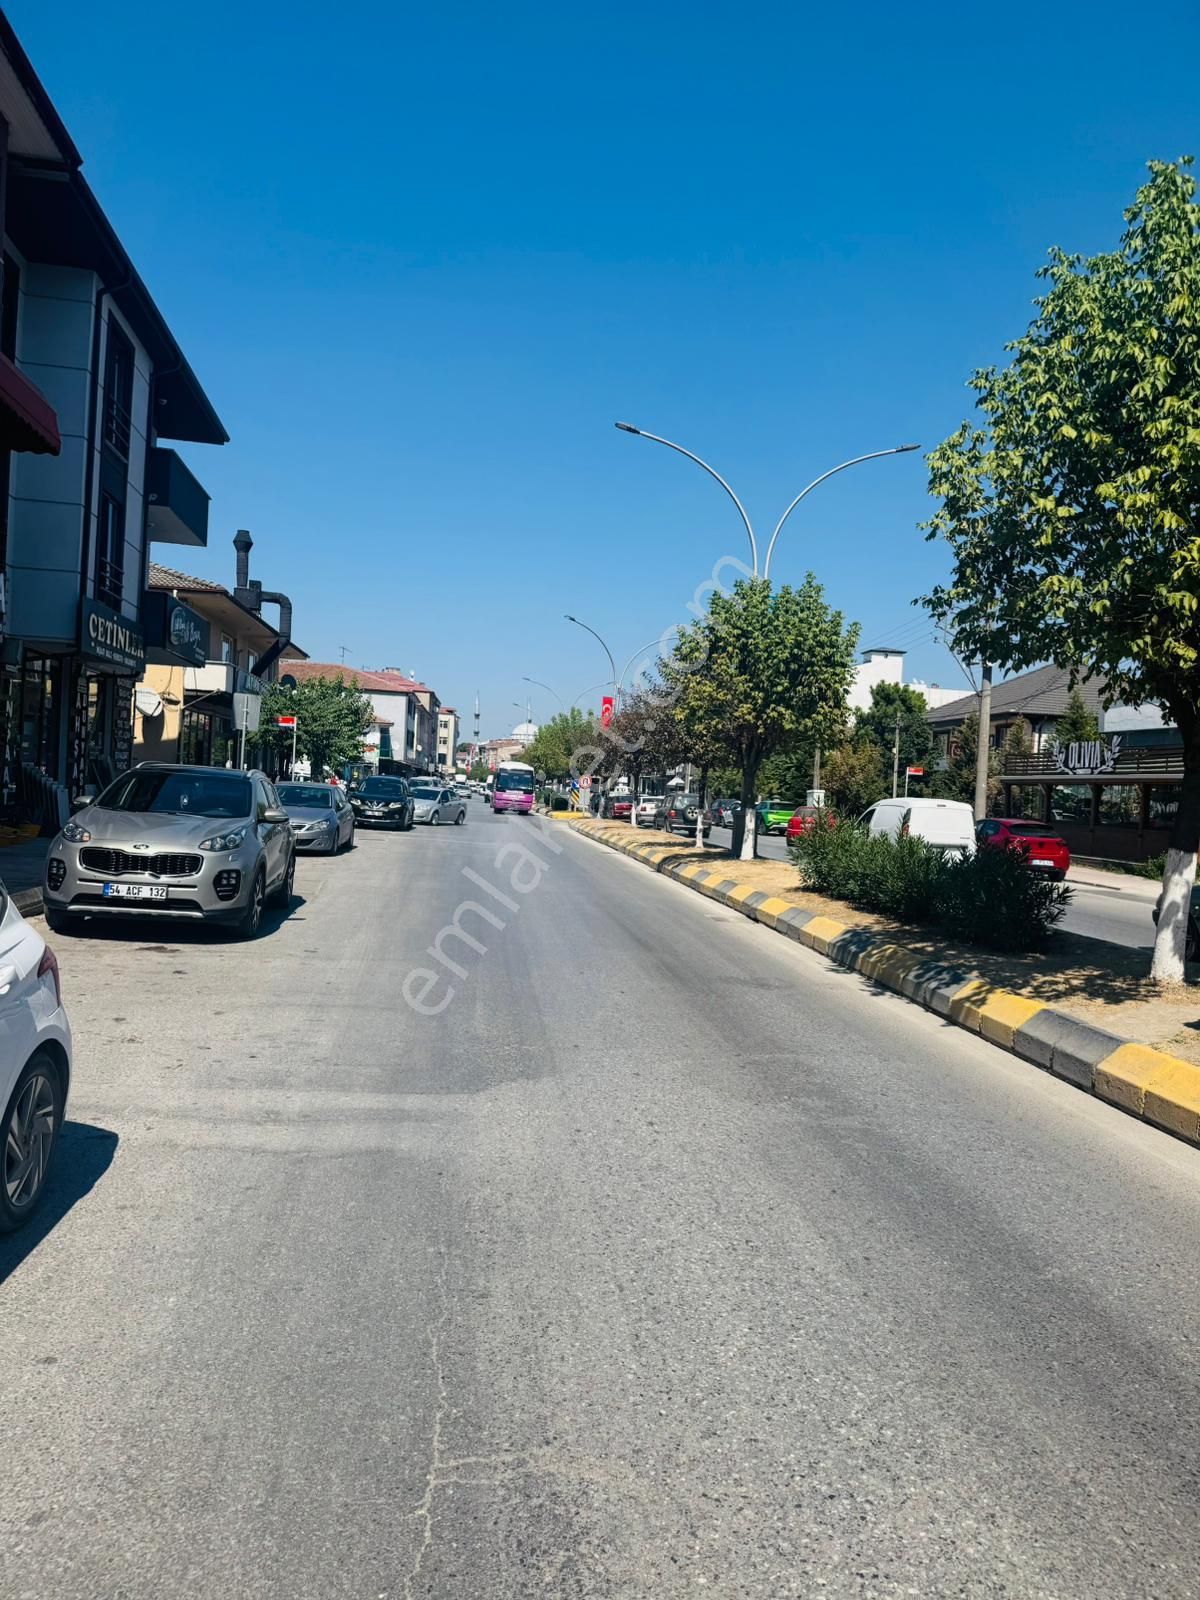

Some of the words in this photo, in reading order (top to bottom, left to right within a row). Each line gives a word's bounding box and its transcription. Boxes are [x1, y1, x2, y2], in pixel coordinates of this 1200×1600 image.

[109, 885, 120, 895] 54
[126, 886, 143, 896] ACF
[149, 887, 166, 897] 132
